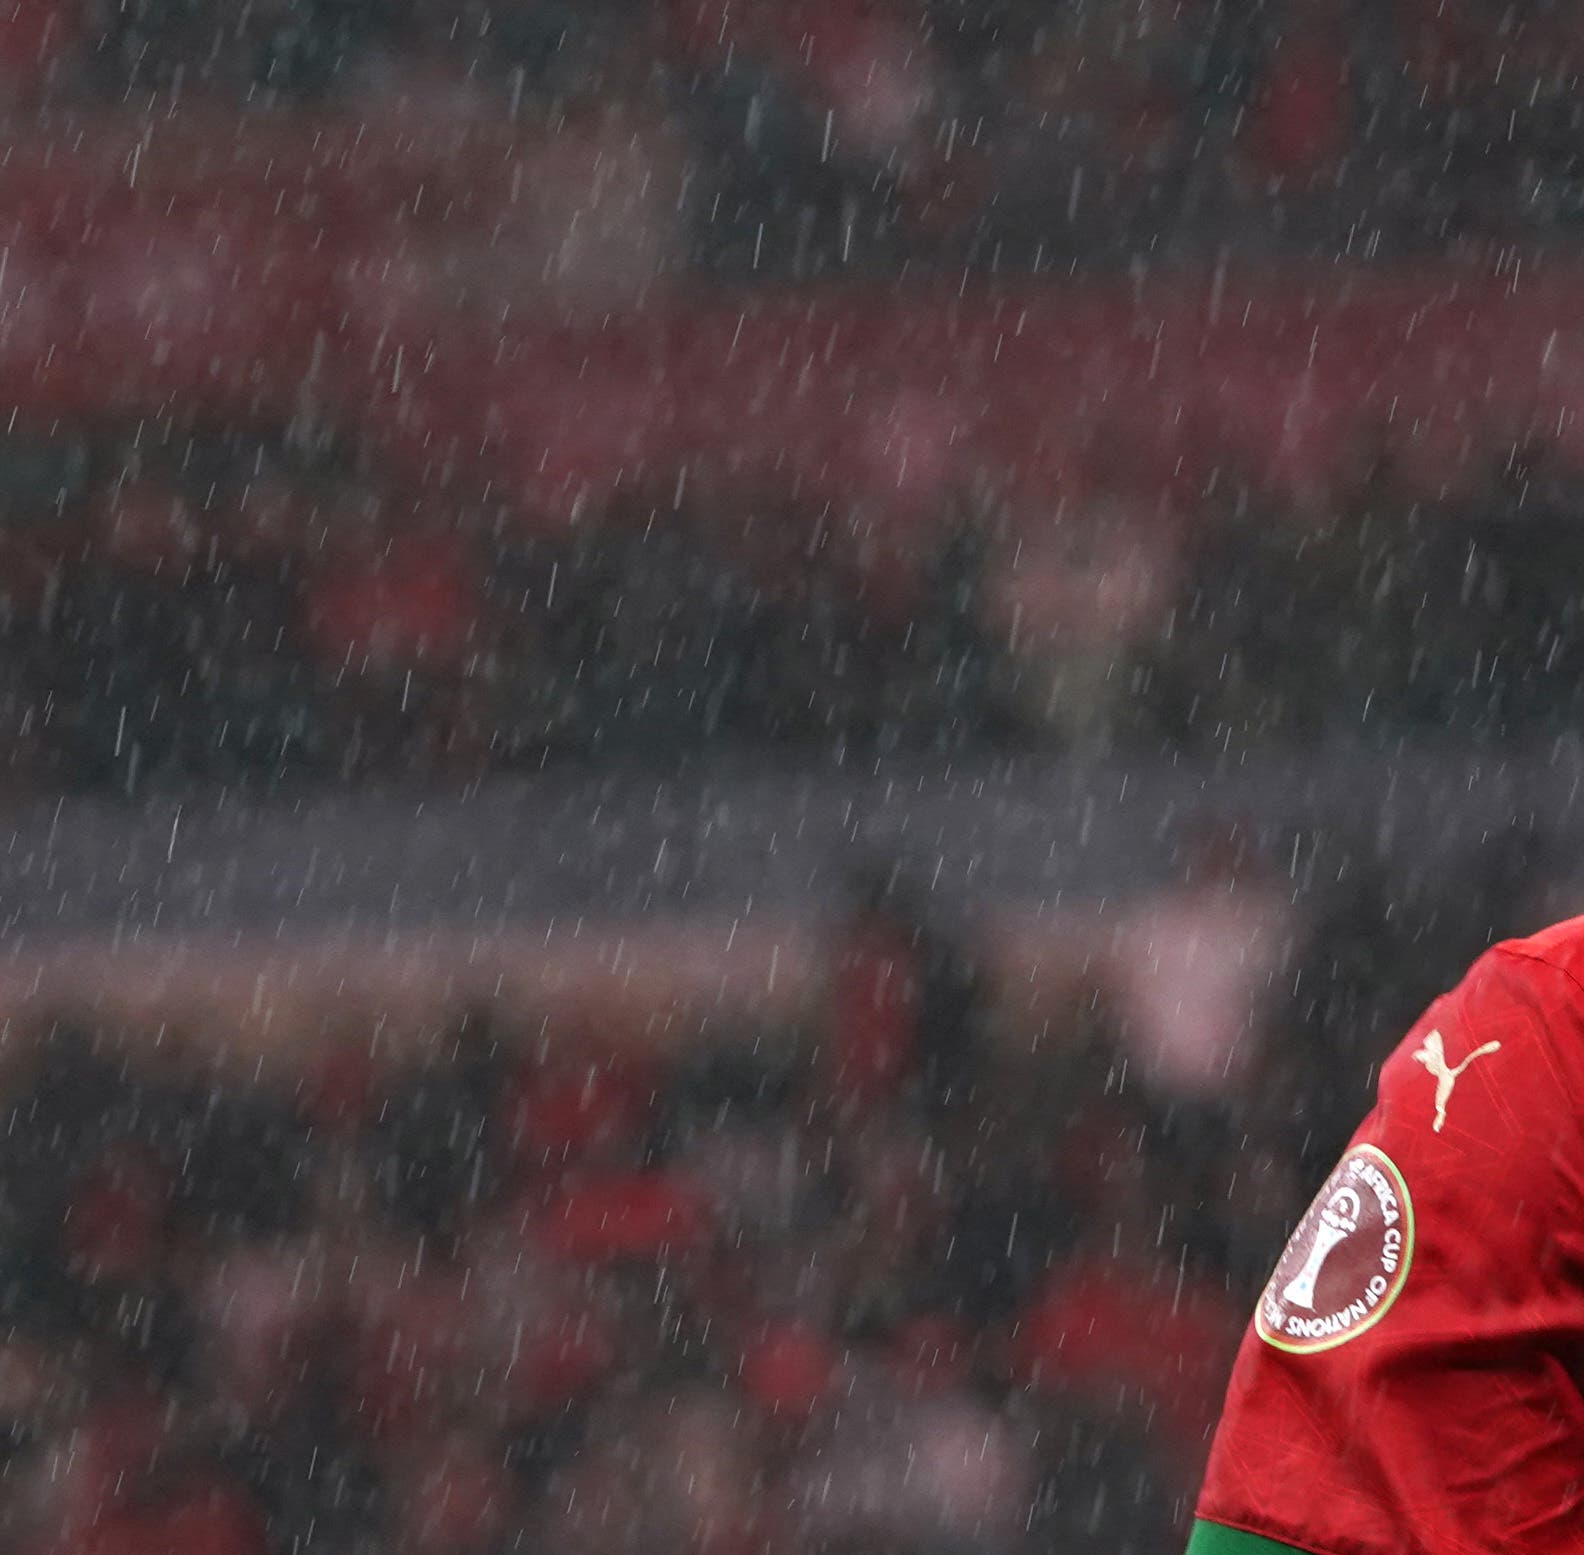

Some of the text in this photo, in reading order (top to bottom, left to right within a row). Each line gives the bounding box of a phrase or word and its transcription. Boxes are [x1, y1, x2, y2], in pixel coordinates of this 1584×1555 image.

[1361, 1164, 1400, 1227] AFRICA
[1380, 1228, 1401, 1274] CUP
[1364, 1275, 1388, 1307] OF
[1285, 1298, 1368, 1337] NATIONS
